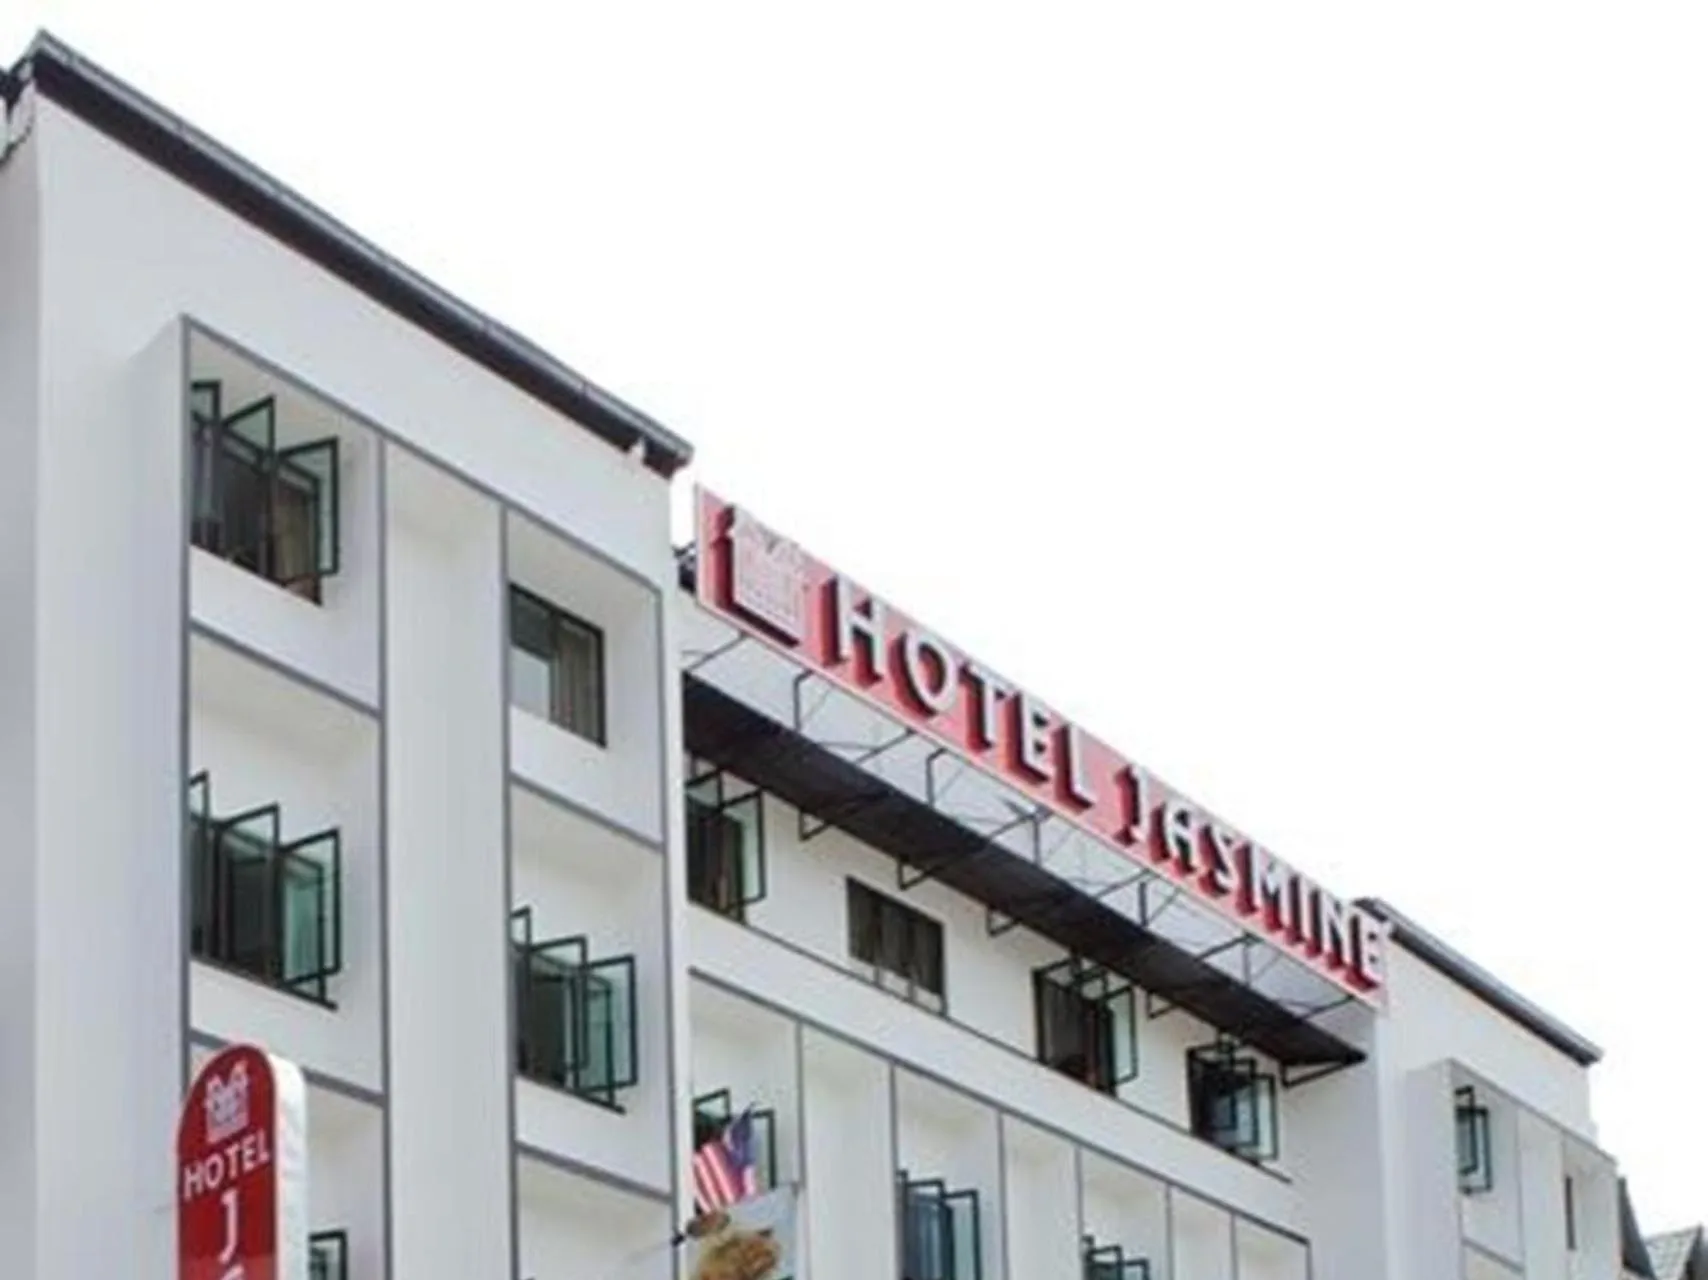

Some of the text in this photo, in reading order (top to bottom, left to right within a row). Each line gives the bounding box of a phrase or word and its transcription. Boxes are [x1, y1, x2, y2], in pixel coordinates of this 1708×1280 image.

[820, 572, 1386, 992] HOTEL JASMINE
[183, 1128, 271, 1203] HOTEL
